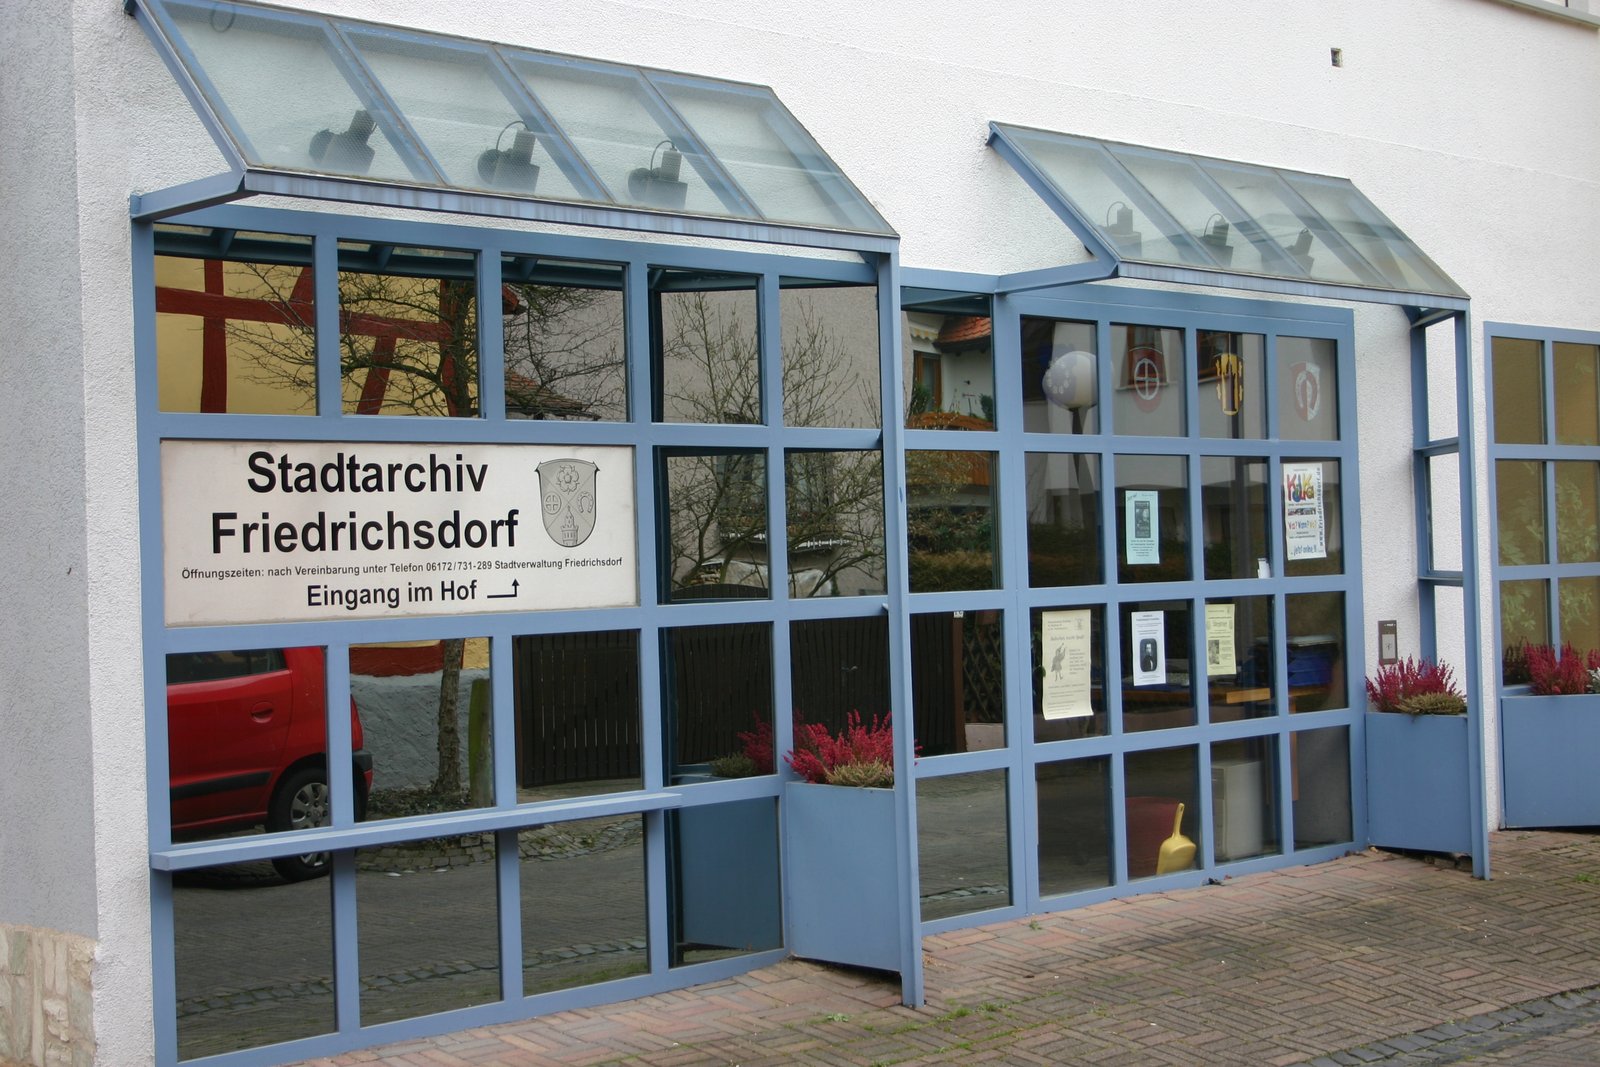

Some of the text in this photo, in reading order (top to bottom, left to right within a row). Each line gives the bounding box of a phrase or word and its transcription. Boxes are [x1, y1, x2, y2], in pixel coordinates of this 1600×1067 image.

[247, 450, 489, 494] Stadtarchiv
[212, 508, 520, 554] Friedrichsdorf
[181, 567, 265, 581] Öffnungszeiten:
[268, 566, 292, 577] nach
[294, 565, 360, 576] Vereinbarung
[363, 564, 388, 574] unter
[390, 563, 424, 573] Telefon
[494, 559, 563, 570] Stadtverwaltung
[564, 557, 622, 568] Friedrichsdorf
[307, 579, 478, 611] Eingang im Hof
